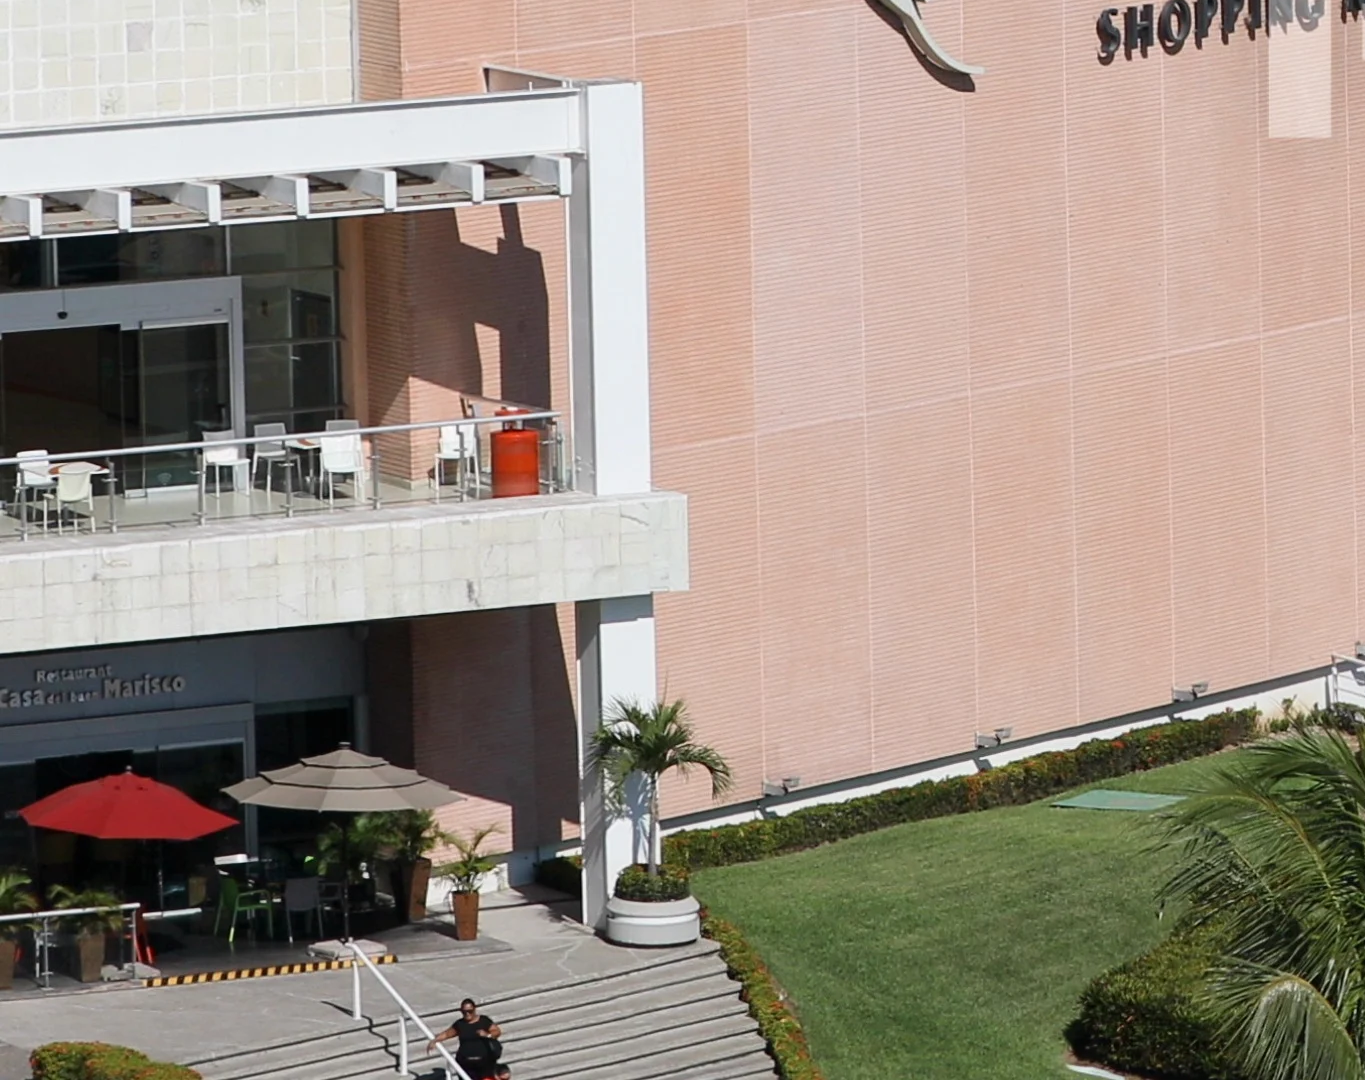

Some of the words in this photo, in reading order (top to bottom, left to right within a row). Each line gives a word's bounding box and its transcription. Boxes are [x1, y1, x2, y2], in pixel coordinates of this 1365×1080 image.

[36, 664, 112, 683] Restaurant
[0, 688, 44, 708] Casa
[103, 674, 187, 700] Marisco
